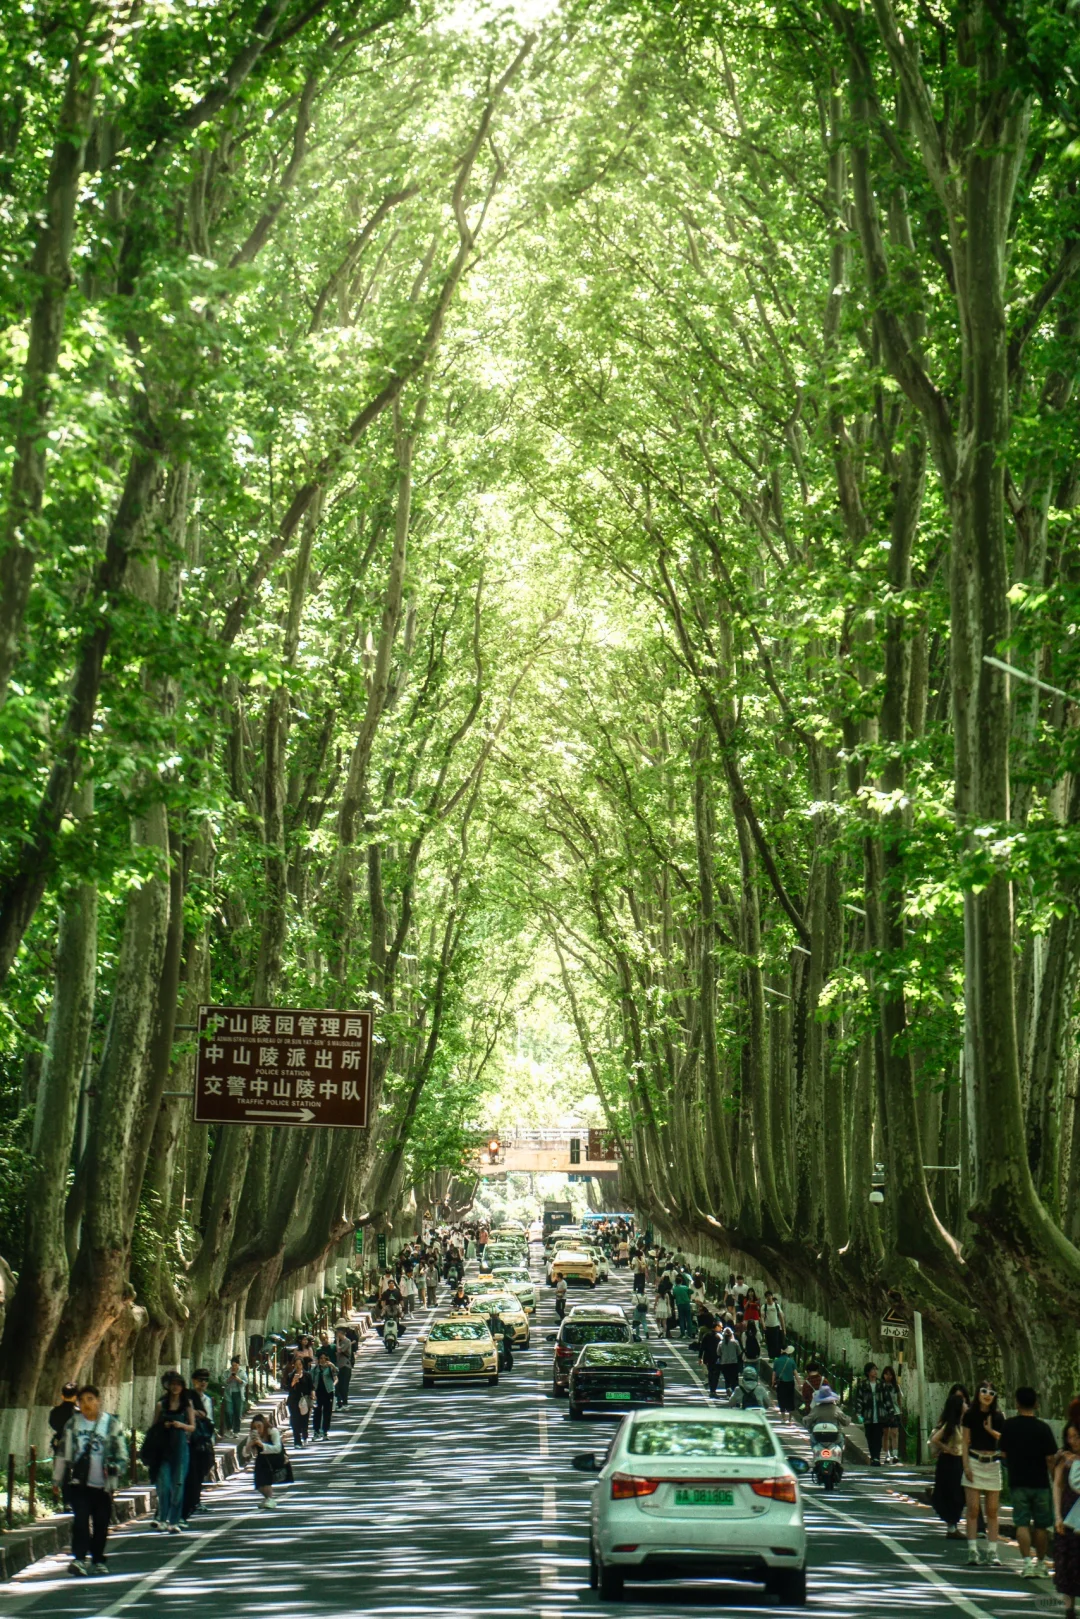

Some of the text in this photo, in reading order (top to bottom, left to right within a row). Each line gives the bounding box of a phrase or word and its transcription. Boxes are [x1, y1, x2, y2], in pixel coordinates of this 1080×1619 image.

[207, 1013, 363, 1038] 中山陵园管理局
[205, 1044, 361, 1070] 中山陵派出所
[255, 1068, 311, 1077] POLICE STATION
[204, 1075, 361, 1101] 交警中山陵中队
[237, 1098, 322, 1108] TRAFFIC POLICE STATION
